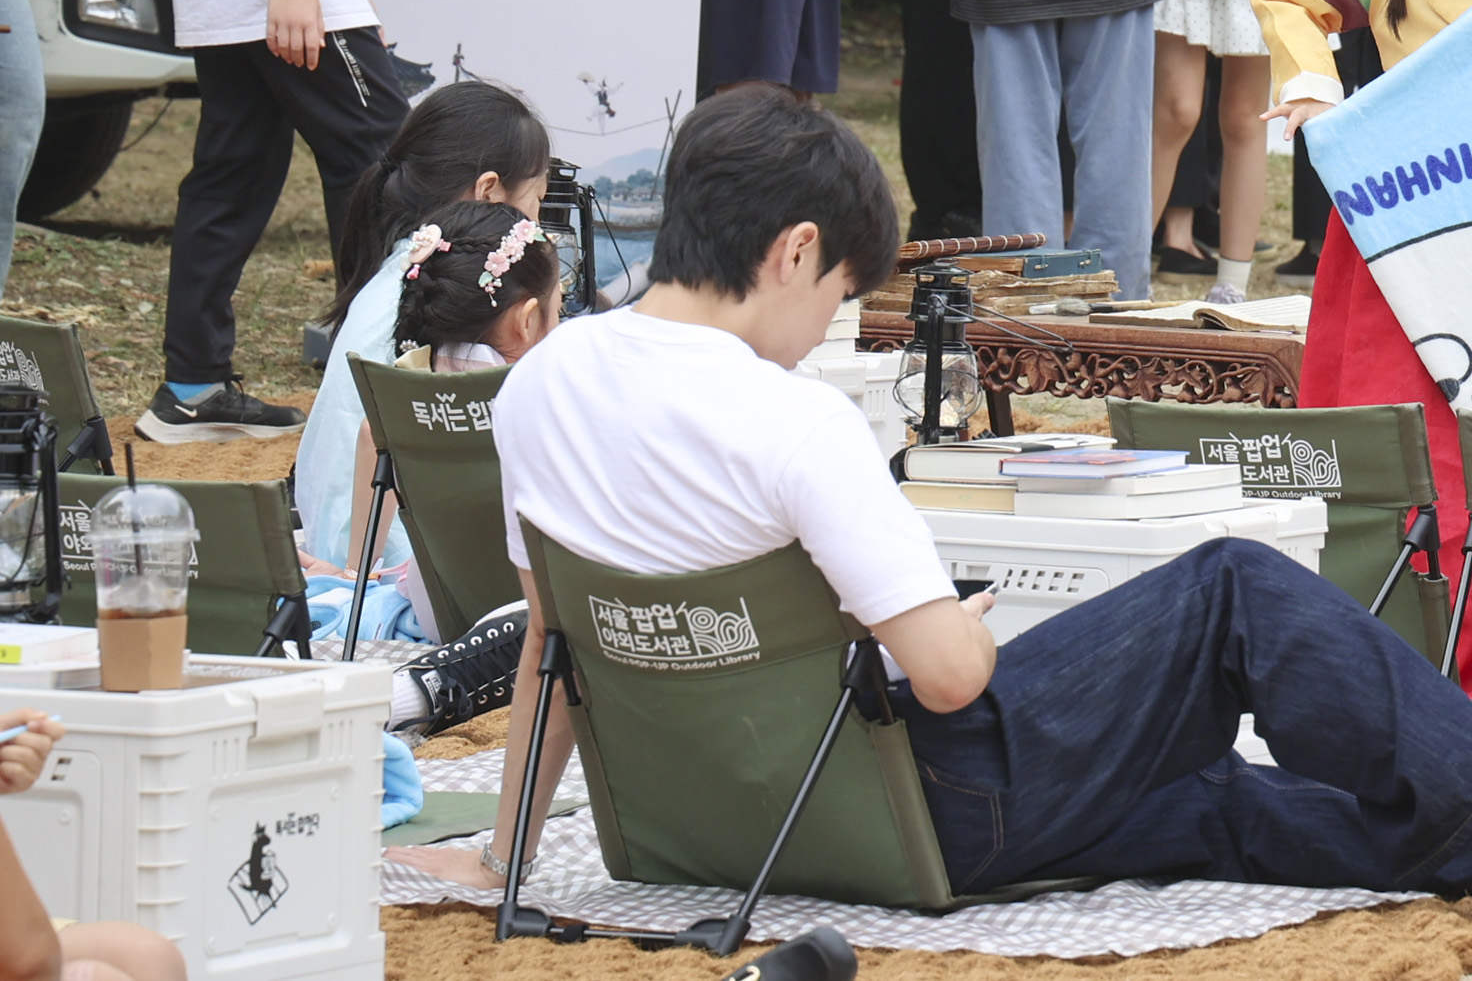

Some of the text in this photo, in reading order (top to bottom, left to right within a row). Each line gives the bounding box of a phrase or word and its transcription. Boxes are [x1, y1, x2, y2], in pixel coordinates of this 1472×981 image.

[411, 392, 496, 432] 독서는 힙
[1208, 433, 1283, 463] 서울 팝업
[1242, 464, 1290, 484] 도서관
[1242, 490, 1342, 500] OP-UP Outdoor Library
[60, 511, 92, 532] 서울
[63, 560, 90, 571] Seoul
[597, 603, 678, 634] 서울 팝업
[602, 626, 692, 656] 야외도서관
[670, 659, 717, 671] Outdoor
[719, 650, 761, 667] Library
